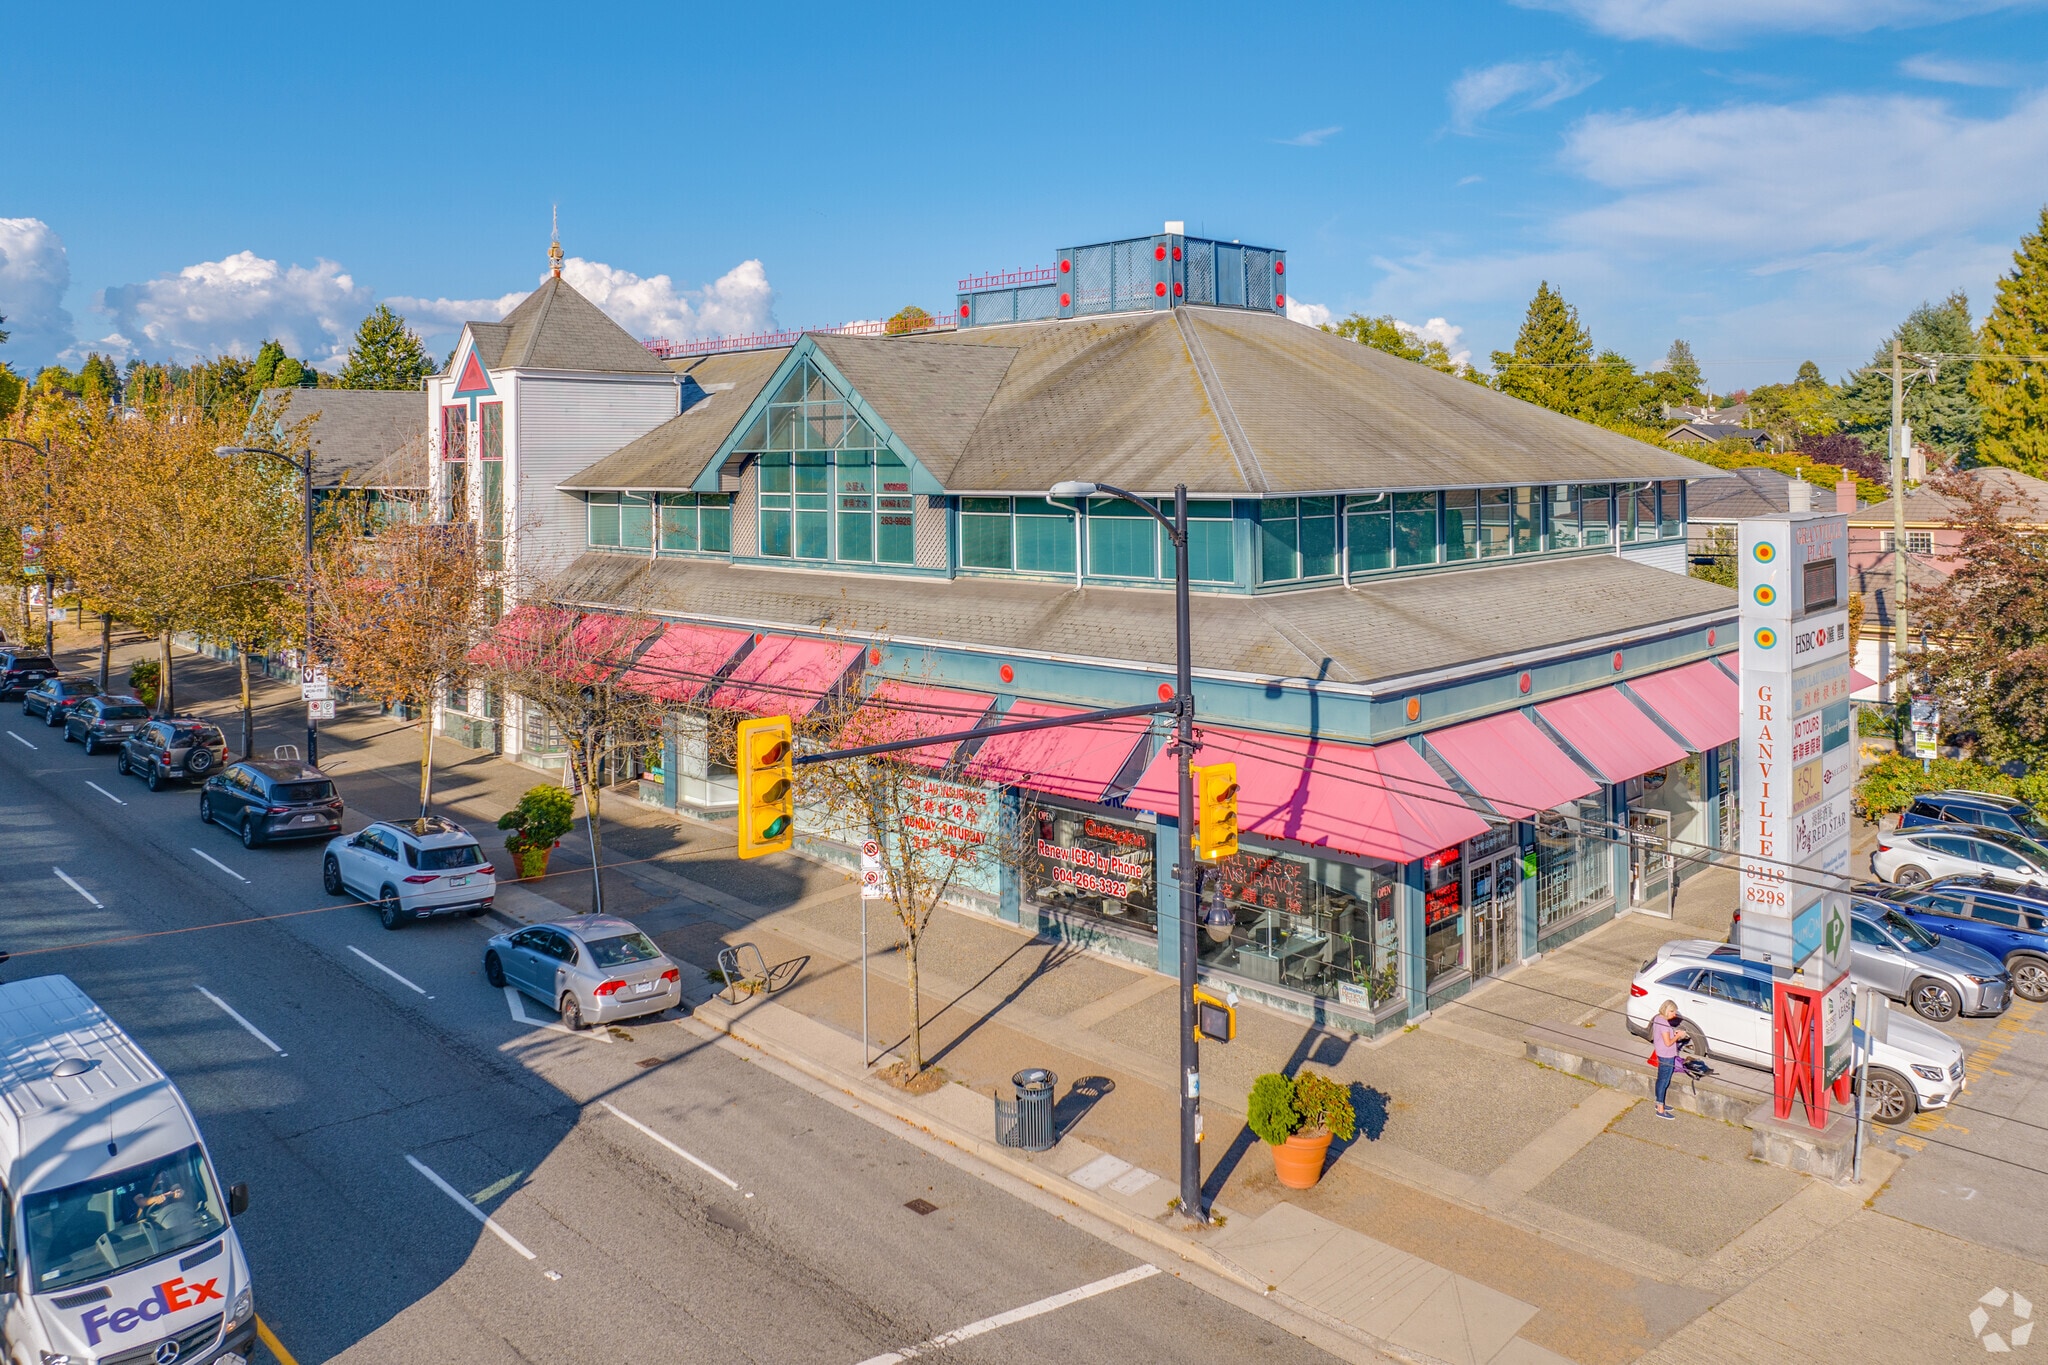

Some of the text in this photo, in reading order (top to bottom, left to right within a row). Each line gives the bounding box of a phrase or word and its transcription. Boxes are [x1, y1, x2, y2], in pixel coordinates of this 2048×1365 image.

[1796, 522, 1843, 545] GRANVILLE
[1807, 541, 1832, 562] PLACE
[1795, 631, 1816, 654] HSBC
[1794, 716, 1819, 739] XO TOURS
[1758, 685, 1773, 857] GRANVILLE
[923, 782, 939, 795] LAU
[1038, 810, 1056, 821] OPEN
[1084, 818, 1147, 848] Autoplan
[1812, 823, 1828, 844] RED
[1828, 811, 1846, 833] STAR
[1037, 839, 1143, 879] Renew ICBC by Phone
[1224, 854, 1303, 878] ALL TYPES OF
[1053, 866, 1128, 898] 604-266-3323
[1221, 864, 1303, 899] INSURANCE
[1746, 863, 1785, 884] 8118
[1377, 884, 1392, 899] OPEN
[1747, 886, 1785, 907] 8298
[1833, 918, 1840, 947] P
[1839, 987, 1848, 1002] FOR
[1838, 1000, 1850, 1019] LEASE
[81, 1277, 224, 1347] FedEx
